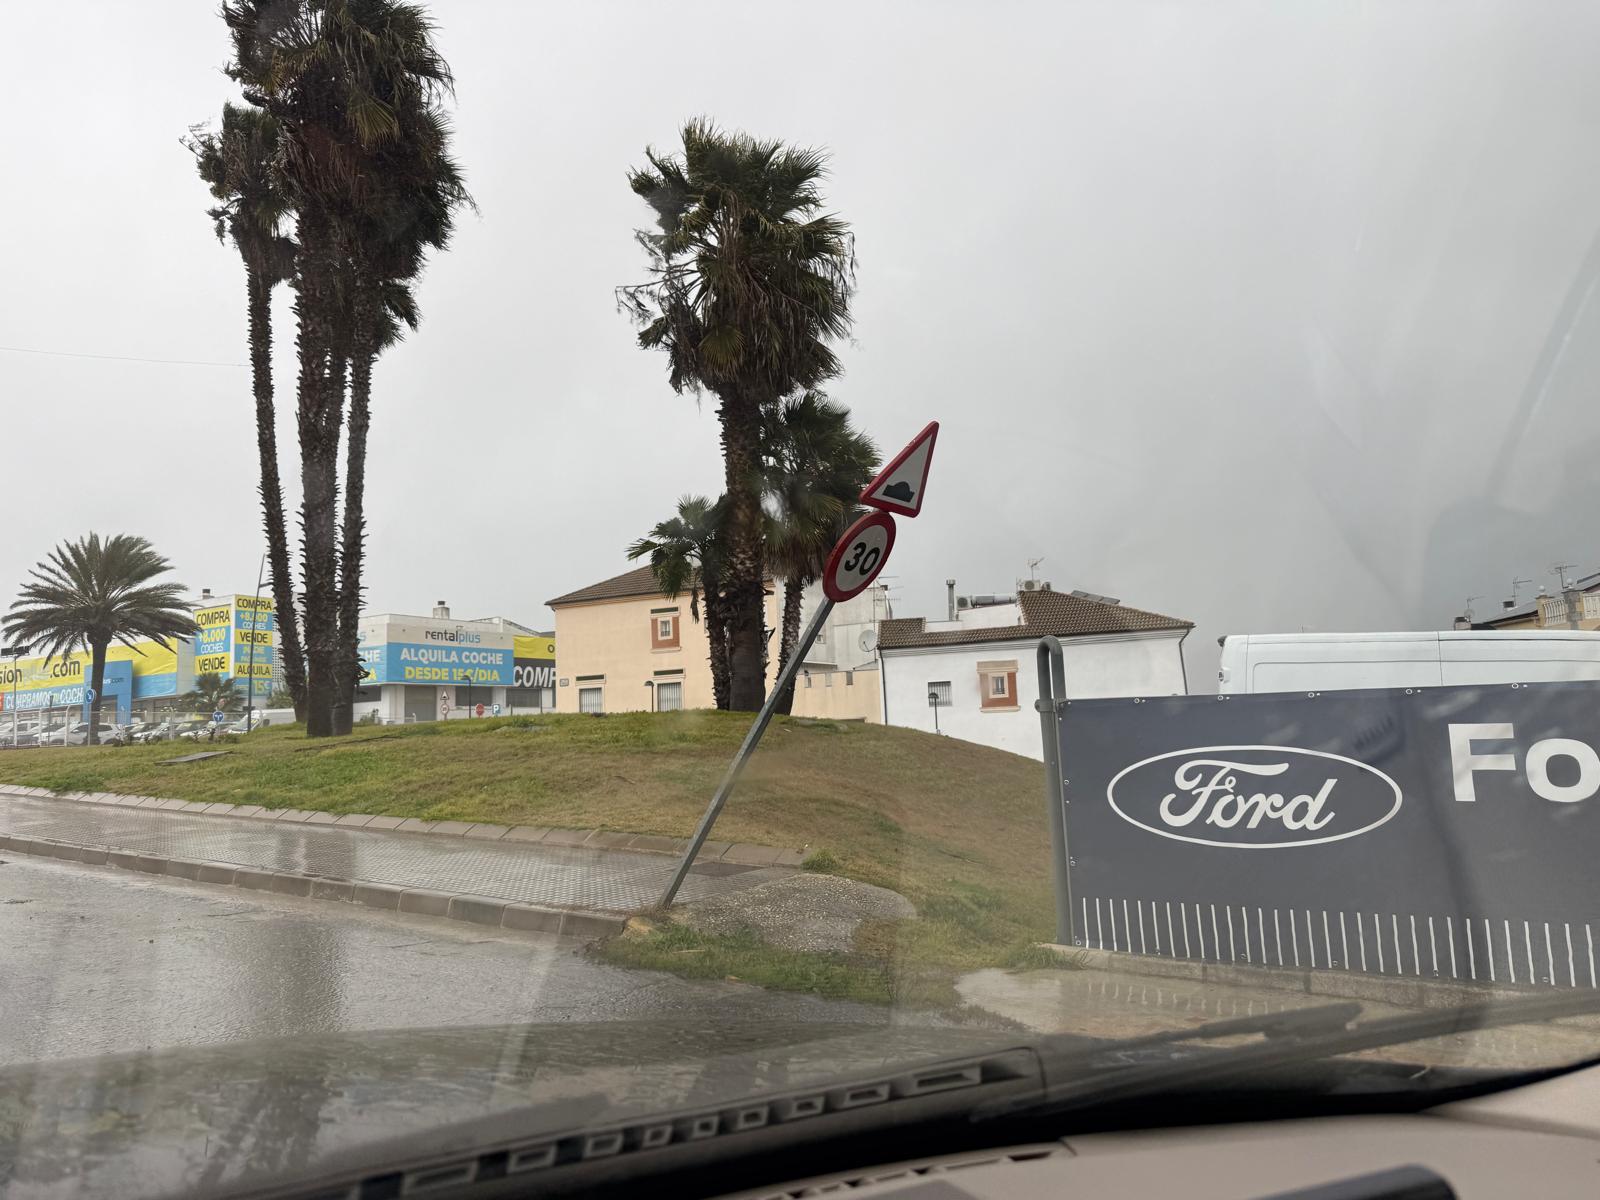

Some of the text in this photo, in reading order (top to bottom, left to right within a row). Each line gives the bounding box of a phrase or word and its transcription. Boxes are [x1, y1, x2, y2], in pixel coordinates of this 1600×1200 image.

[844, 541, 881, 576] 30
[236, 598, 272, 610] COMPRA
[196, 610, 231, 626] COMPRA
[240, 612, 268, 622] +8.00
[240, 631, 268, 643] VENDE
[425, 630, 481, 644] rentalplus
[200, 642, 224, 654] COCHES
[198, 656, 225, 671] VENDE
[400, 648, 503, 665] ALQUILA COCHE
[236, 665, 271, 676] ALQUILA
[405, 666, 449, 680] DESDE
[1158, 759, 1339, 831] Ford
